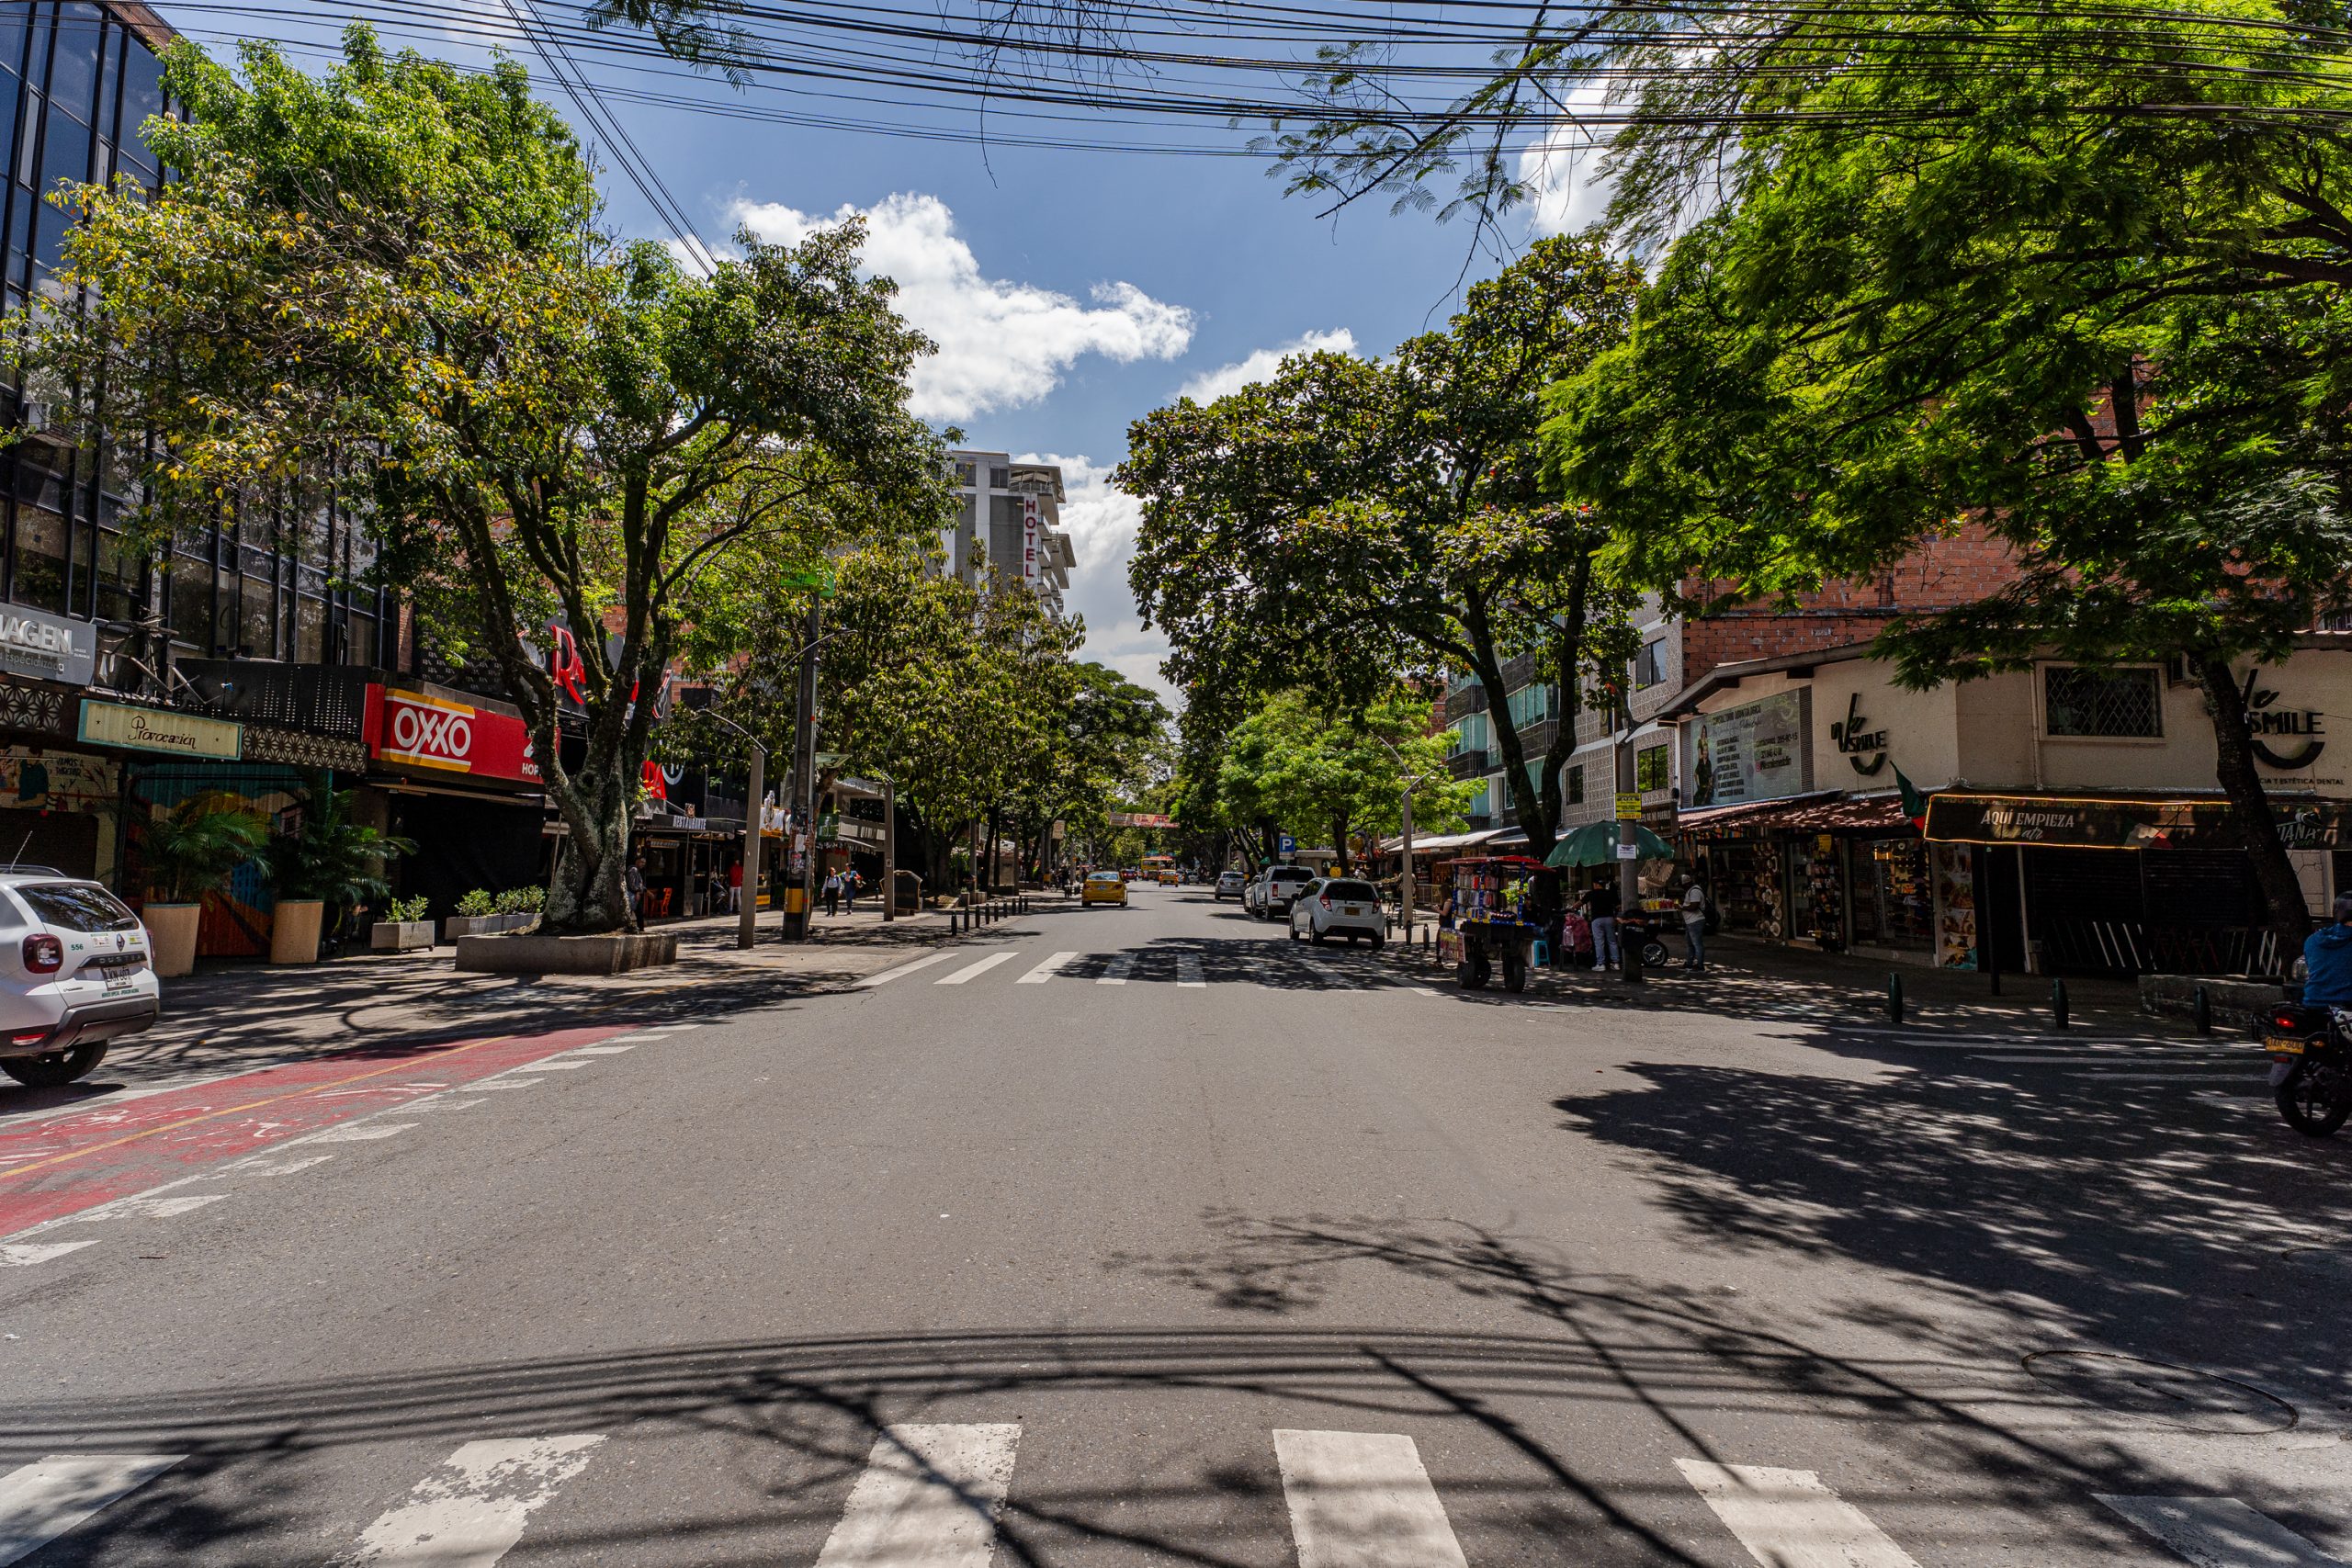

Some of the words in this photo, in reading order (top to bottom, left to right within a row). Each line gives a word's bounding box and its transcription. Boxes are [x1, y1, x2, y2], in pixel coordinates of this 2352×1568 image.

[1025, 500, 1036, 577] HOTEL
[0, 615, 73, 655] AGEN
[128, 716, 196, 750] Provocación
[395, 707, 471, 757] OXXO
[2249, 711, 2325, 735] SMILE
[1849, 730, 1888, 752] SMILE
[1981, 808, 2014, 825] AQUÍ
[2016, 813, 2075, 828] EMPIEZA
[1283, 839, 1293, 851] P
